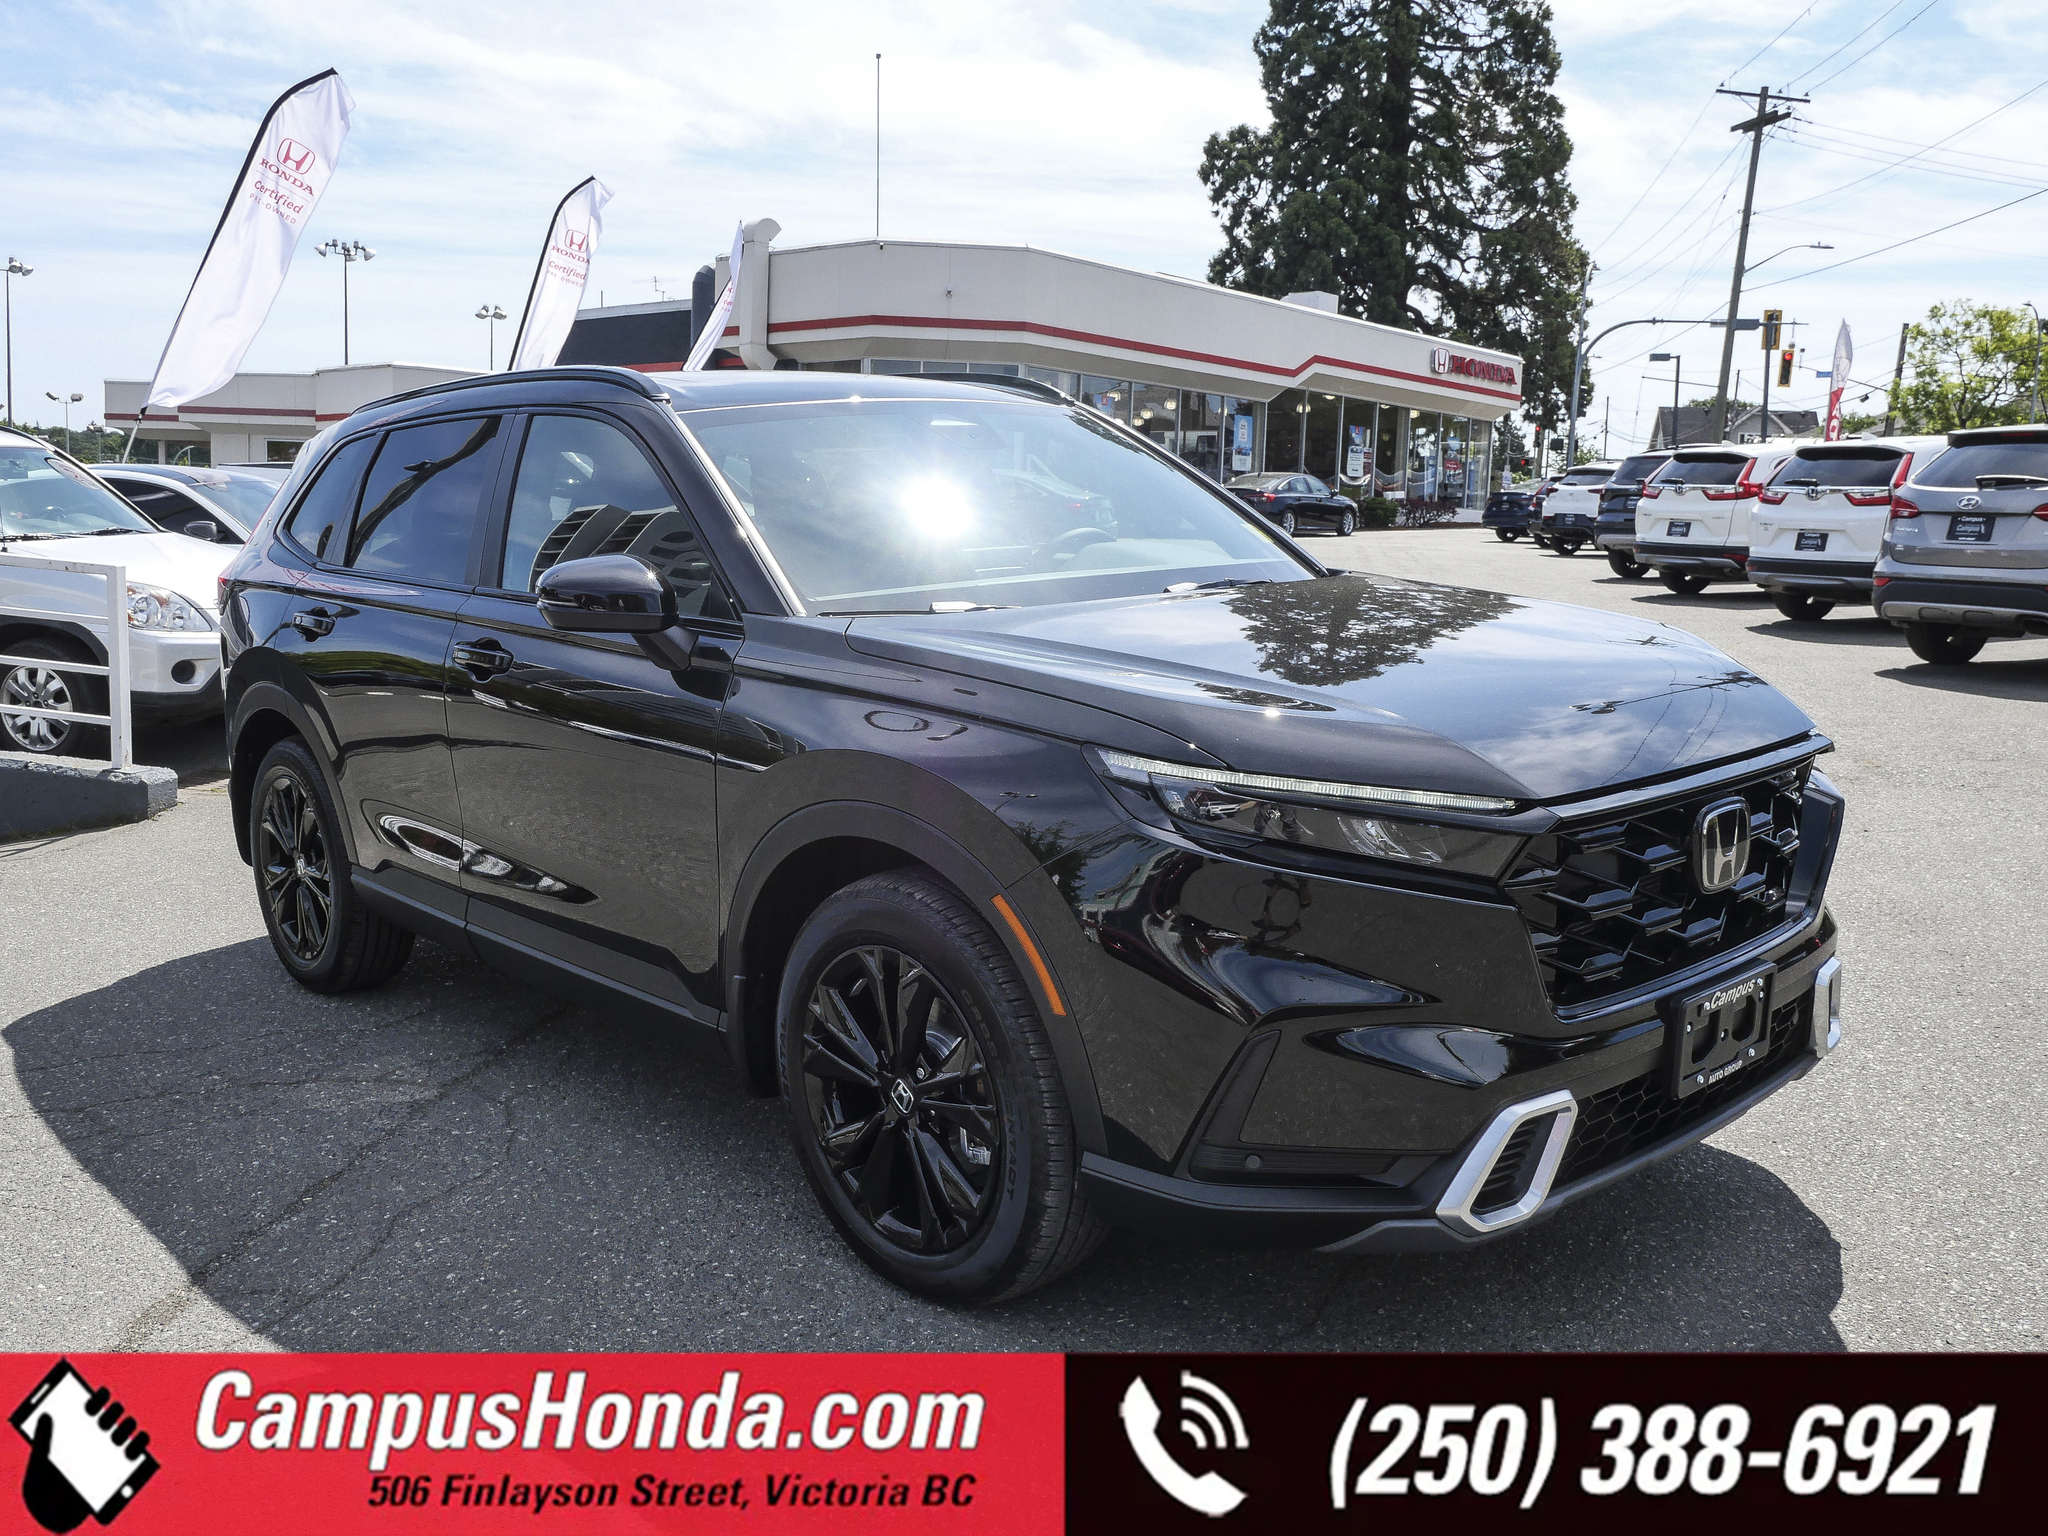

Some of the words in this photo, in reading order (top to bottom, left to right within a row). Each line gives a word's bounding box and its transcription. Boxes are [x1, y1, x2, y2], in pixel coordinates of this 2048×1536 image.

[259, 157, 314, 197] HONDA
[250, 192, 297, 225] PRE-OWNED
[254, 180, 304, 214] Certified
[551, 244, 590, 265] HONDA
[549, 260, 587, 280] Certified
[1451, 354, 1517, 385] HONDA
[1711, 979, 1756, 1009] Campus
[1709, 1069, 1724, 1085] AUTO
[1724, 1060, 1743, 1076] GROUP
